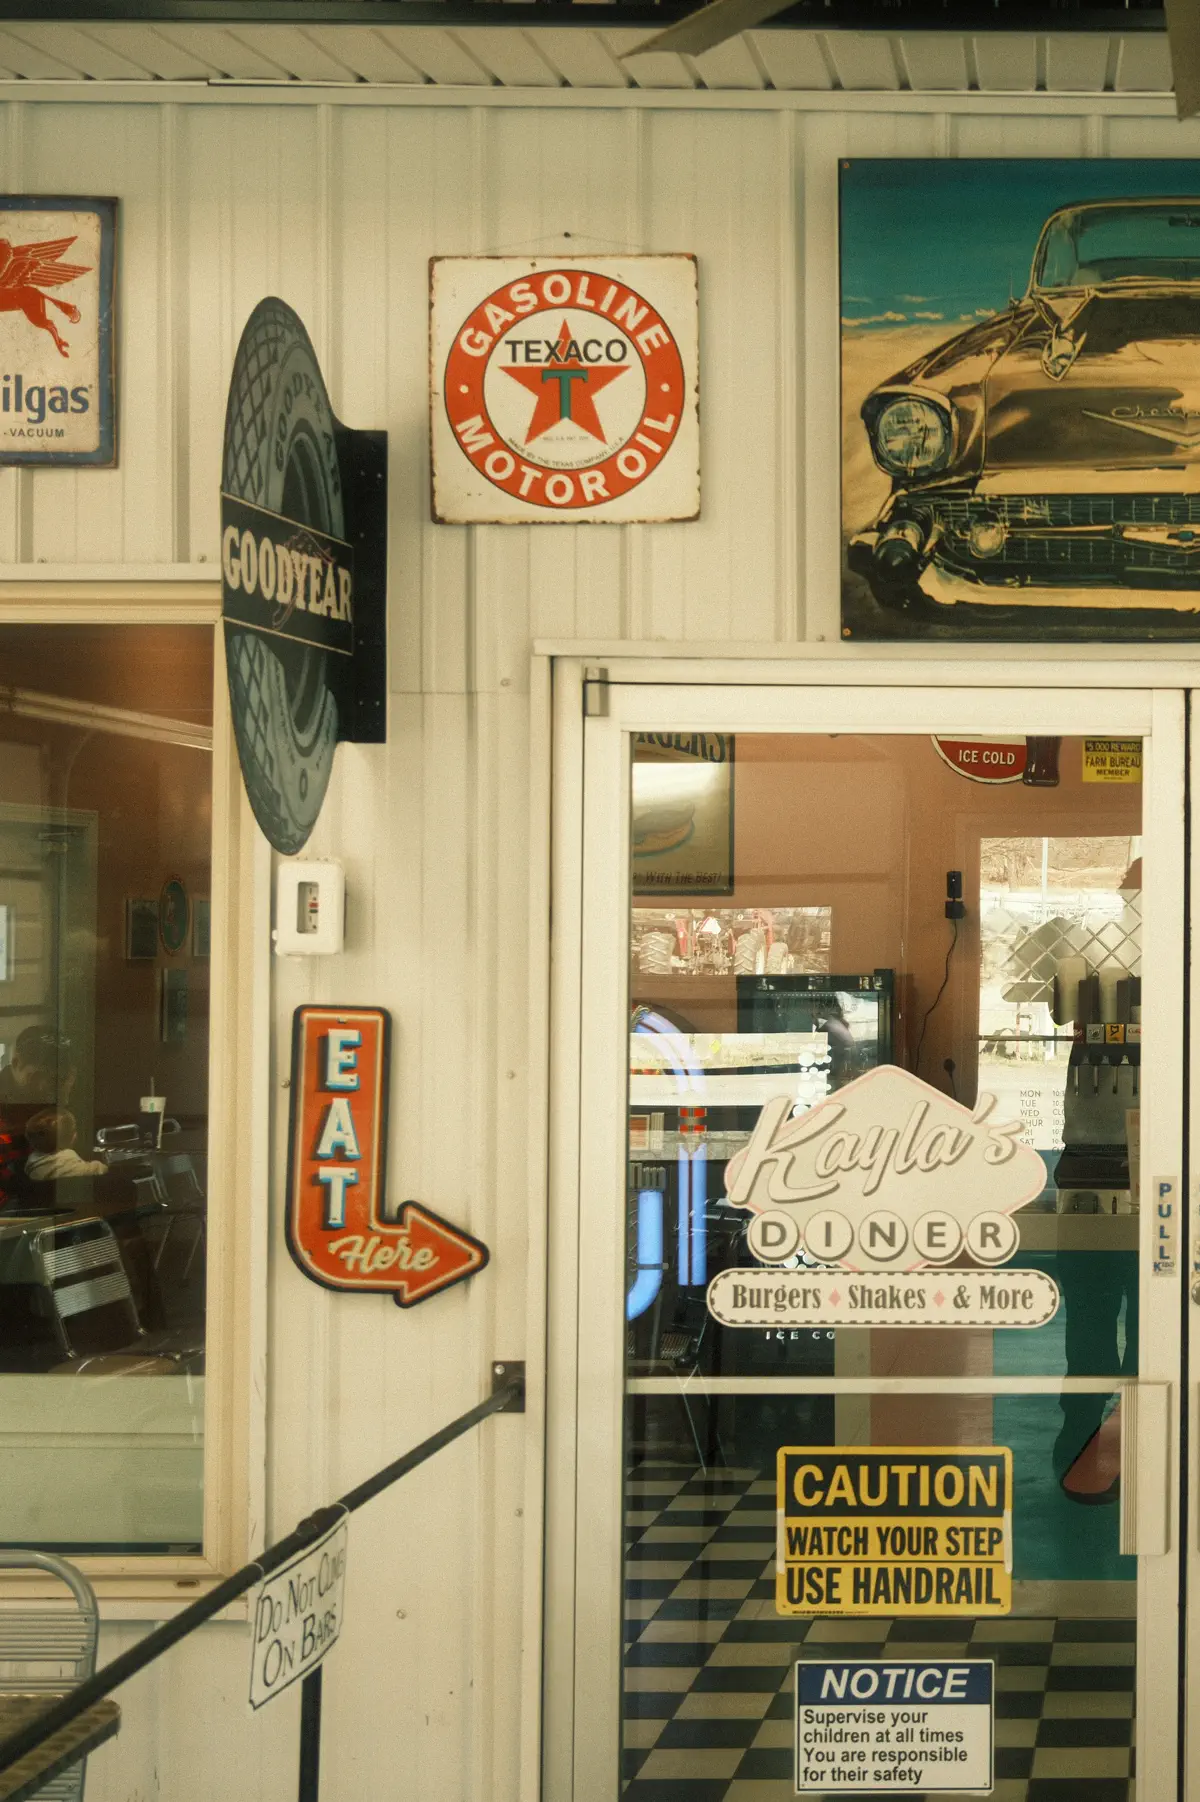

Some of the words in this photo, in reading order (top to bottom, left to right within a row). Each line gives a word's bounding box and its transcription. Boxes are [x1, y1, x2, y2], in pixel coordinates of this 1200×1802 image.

[459, 274, 671, 357] GASOLINE
[504, 338, 628, 364] TEXACO
[456, 414, 611, 505] MOTOR
[616, 413, 675, 480] OIL
[222, 524, 354, 624] GOODYEAR
[959, 749, 979, 763] ICE
[982, 750, 1016, 765] COLD
[1085, 755, 1107, 768] FARM
[1109, 755, 1141, 768] BUREAU
[1020, 1090, 1042, 1098] MON
[1020, 1099, 1037, 1108] TUE
[1020, 1109, 1040, 1117] WED
[315, 1027, 363, 1230] EAT
[728, 1091, 1026, 1206] Kayla's
[758, 1219, 1003, 1248] DINER
[1157, 1182, 1173, 1260] PULL
[328, 1234, 440, 1273] Here
[731, 1284, 822, 1313] Burgers
[848, 1284, 927, 1310] Shakes
[952, 1284, 972, 1310] &
[979, 1284, 1034, 1310] More
[765, 1330, 799, 1341] ICE
[792, 1463, 998, 1507] CAUTION
[786, 1526, 869, 1556] WATCH
[876, 1526, 939, 1556] YOUR
[945, 1526, 1003, 1556] STEP
[786, 1566, 842, 1605] USE
[852, 1566, 1002, 1605] HANDRAIL
[258, 1594, 283, 1643] DO
[285, 1573, 316, 1624] NOT
[263, 1639, 296, 1688] ON
[820, 1667, 971, 1700] NOTICE
[803, 1708, 886, 1727] Supervise
[890, 1712, 929, 1728] your
[803, 1728, 871, 1744] children
[875, 1729, 891, 1744] at
[895, 1728, 915, 1744] all
[918, 1728, 965, 1744] times
[803, 1747, 836, 1764] You
[840, 1750, 867, 1763] are
[871, 1747, 969, 1766] responsible
[803, 1767, 827, 1782] for
[831, 1766, 869, 1782] their
[873, 1766, 924, 1785] safety
